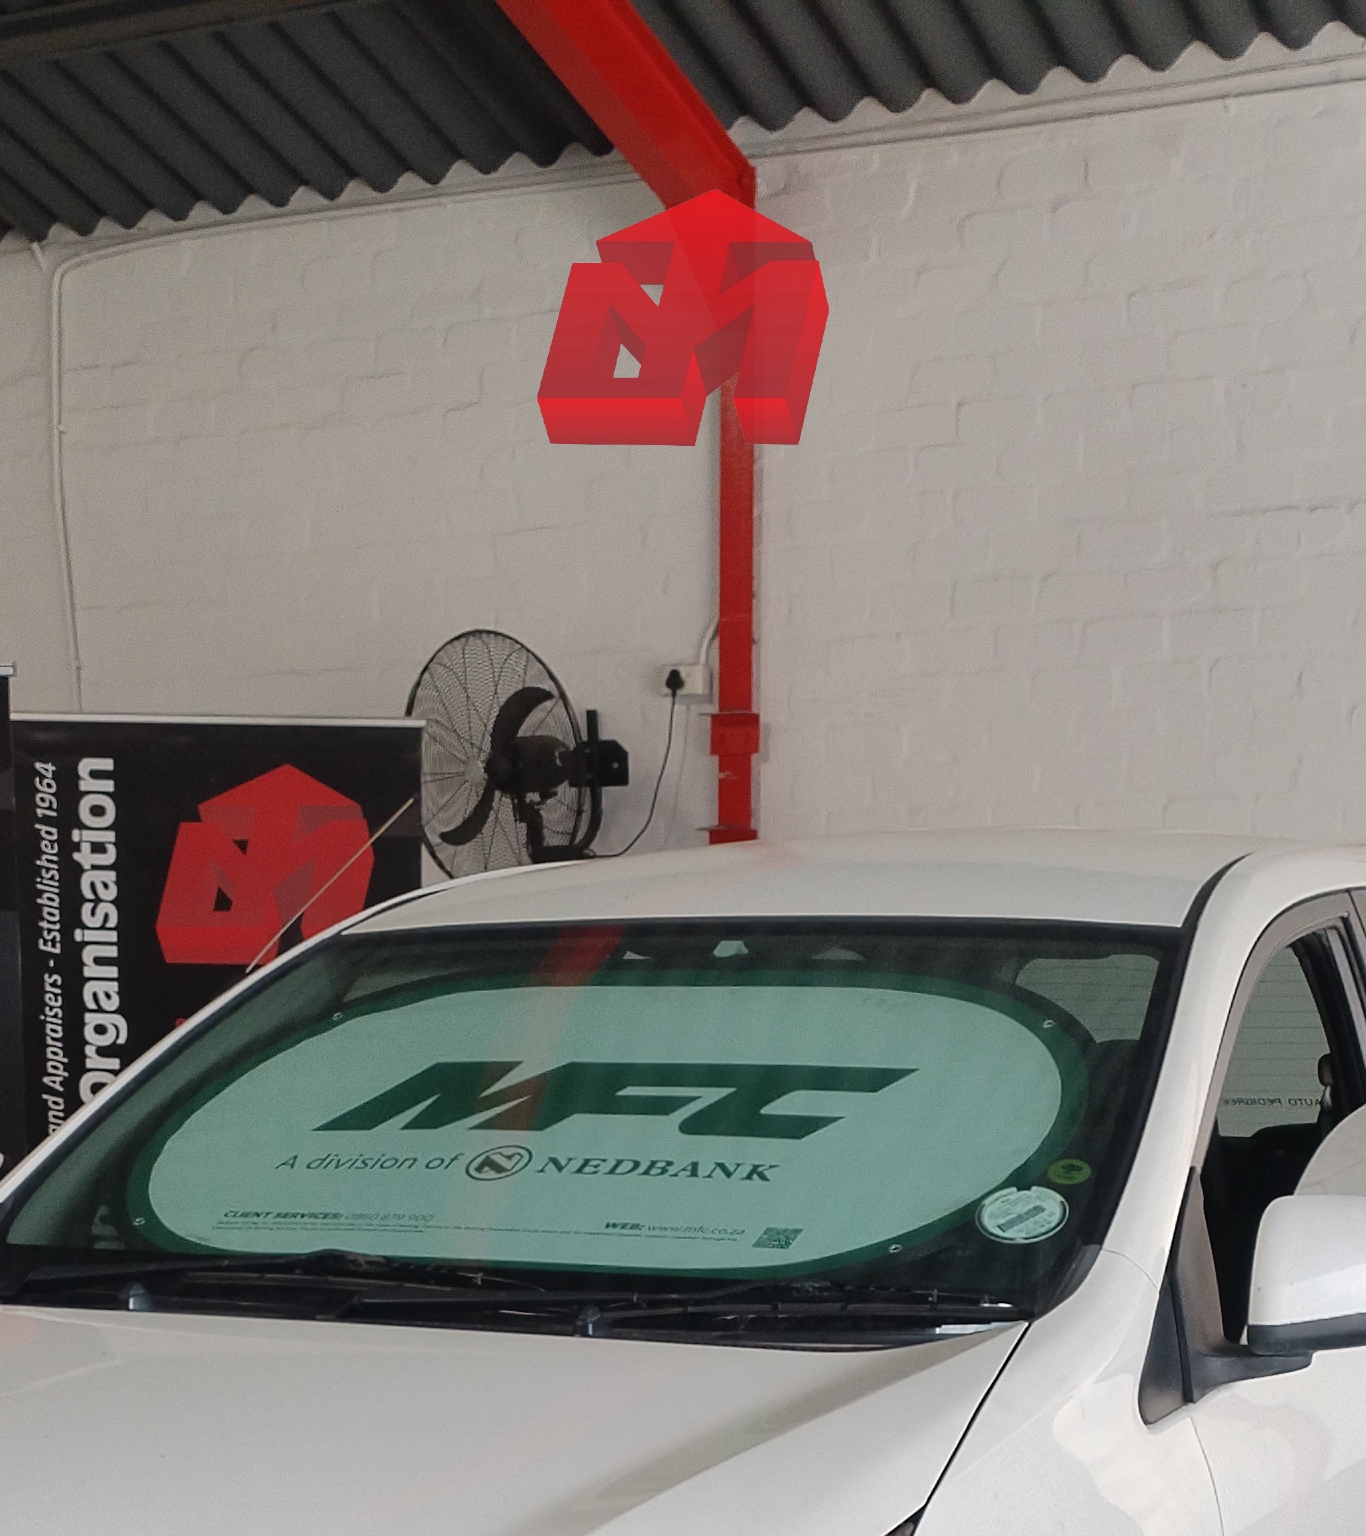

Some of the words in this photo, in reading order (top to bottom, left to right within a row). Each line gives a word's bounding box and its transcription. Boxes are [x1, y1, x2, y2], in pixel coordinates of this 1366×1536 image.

[35, 761, 59, 819] 1964
[36, 823, 62, 956] Established
[39, 973, 70, 1092] Appraisers
[312, 1060, 920, 1140] MFC
[275, 1154, 297, 1170] A
[305, 1152, 416, 1171] division
[425, 1151, 466, 1172] of
[535, 1155, 781, 1182] NEDBANK
[223, 1210, 273, 1220] CLIENT
